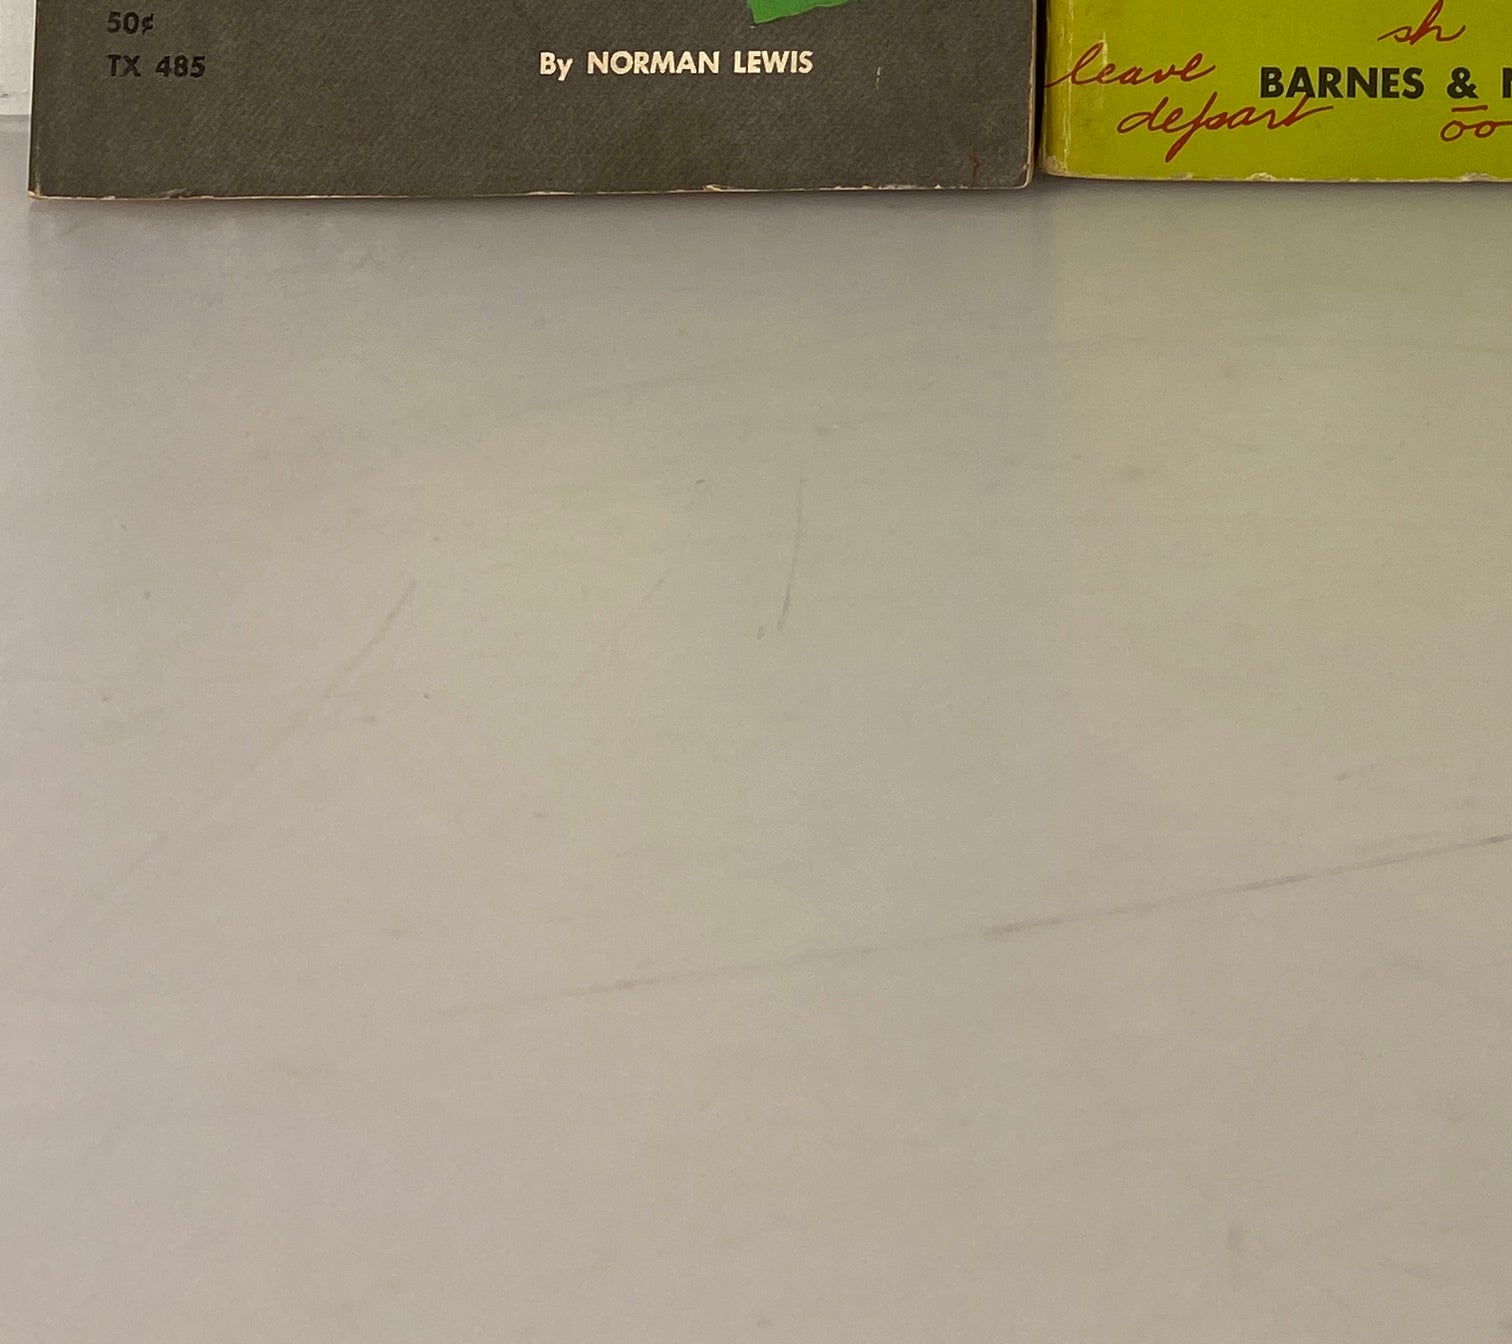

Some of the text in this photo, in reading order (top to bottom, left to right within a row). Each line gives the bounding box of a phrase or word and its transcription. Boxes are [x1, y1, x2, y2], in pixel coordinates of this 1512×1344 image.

[107, 12, 154, 35] 50¢
[108, 55, 206, 78] TX 485
[540, 50, 814, 81] By NORMAN LEWIS
[1045, 42, 1216, 89] leave
[1259, 66, 1424, 100] BARNES
[1446, 66, 1479, 100] &
[1116, 91, 1334, 164] depart
